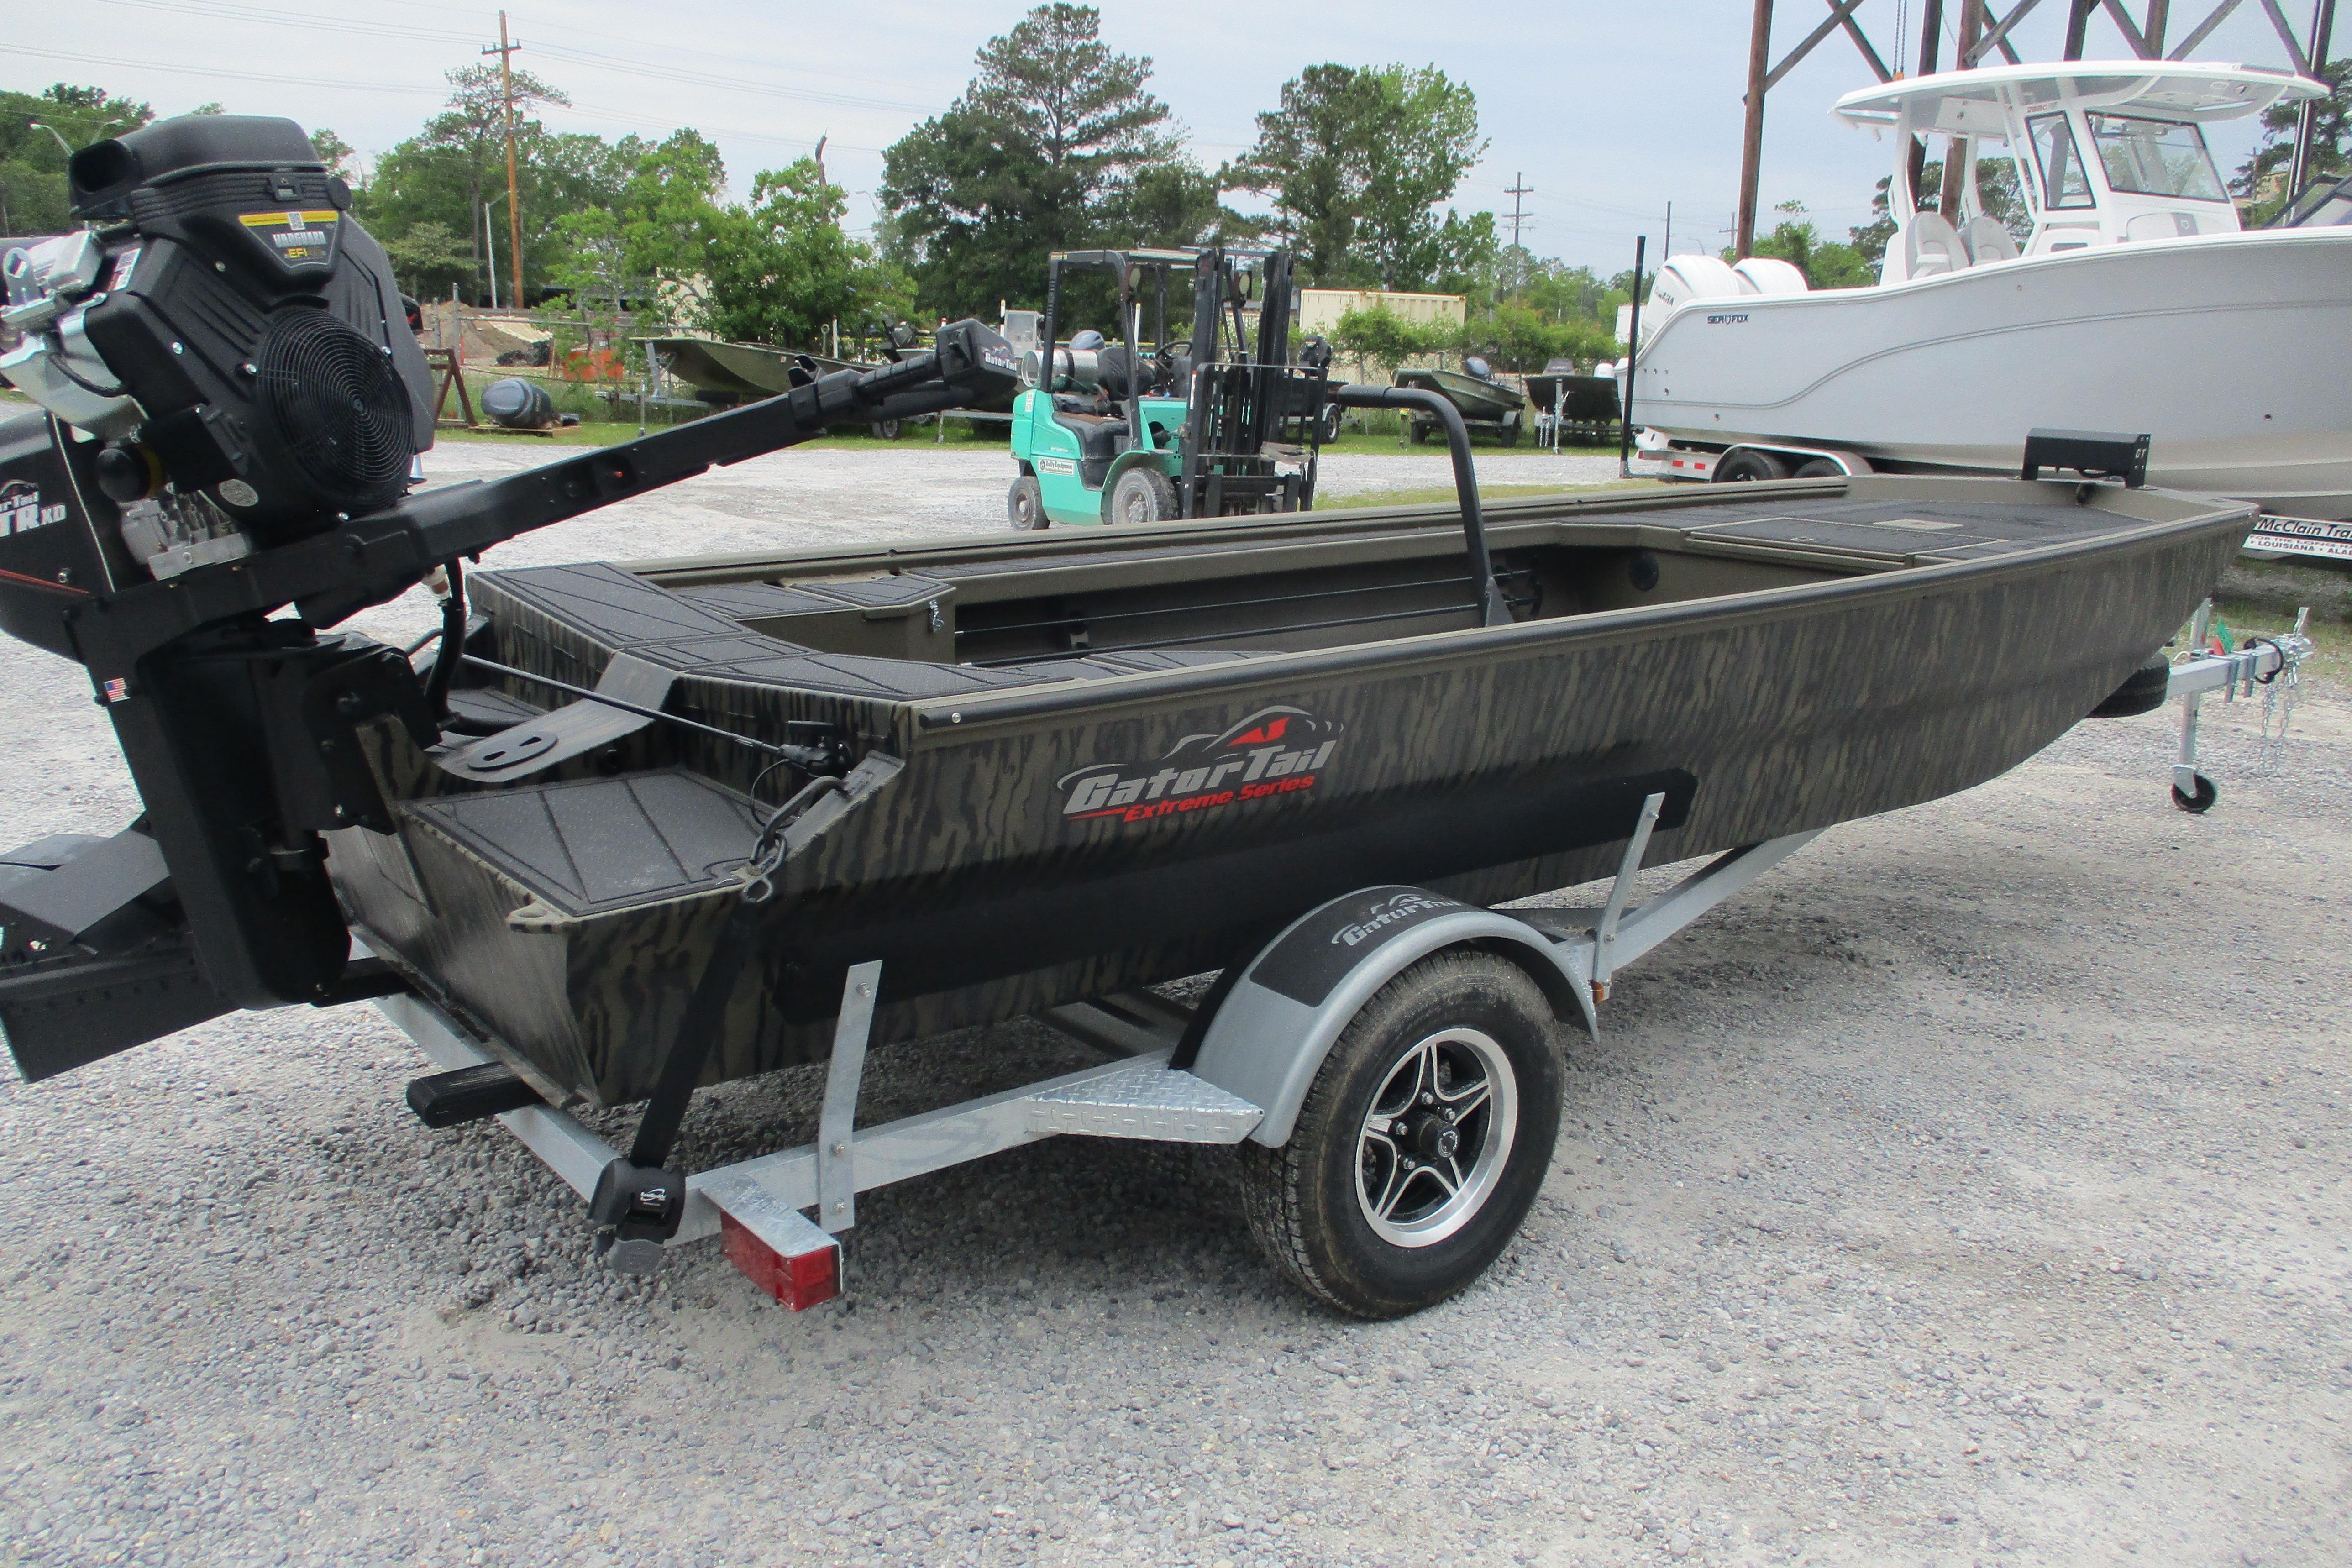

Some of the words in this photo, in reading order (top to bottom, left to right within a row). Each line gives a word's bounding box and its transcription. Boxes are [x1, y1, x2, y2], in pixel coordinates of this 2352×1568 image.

[287, 247, 308, 258] EFI
[985, 352, 1017, 371] GatorTail
[2258, 518, 2321, 535] McClain
[2258, 540, 2315, 551] LOUISIANA
[1063, 740, 1338, 814] GatorTail
[1124, 791, 1234, 822] Extreme
[1238, 776, 1316, 801] Series
[1343, 900, 1462, 946] GatorTail
